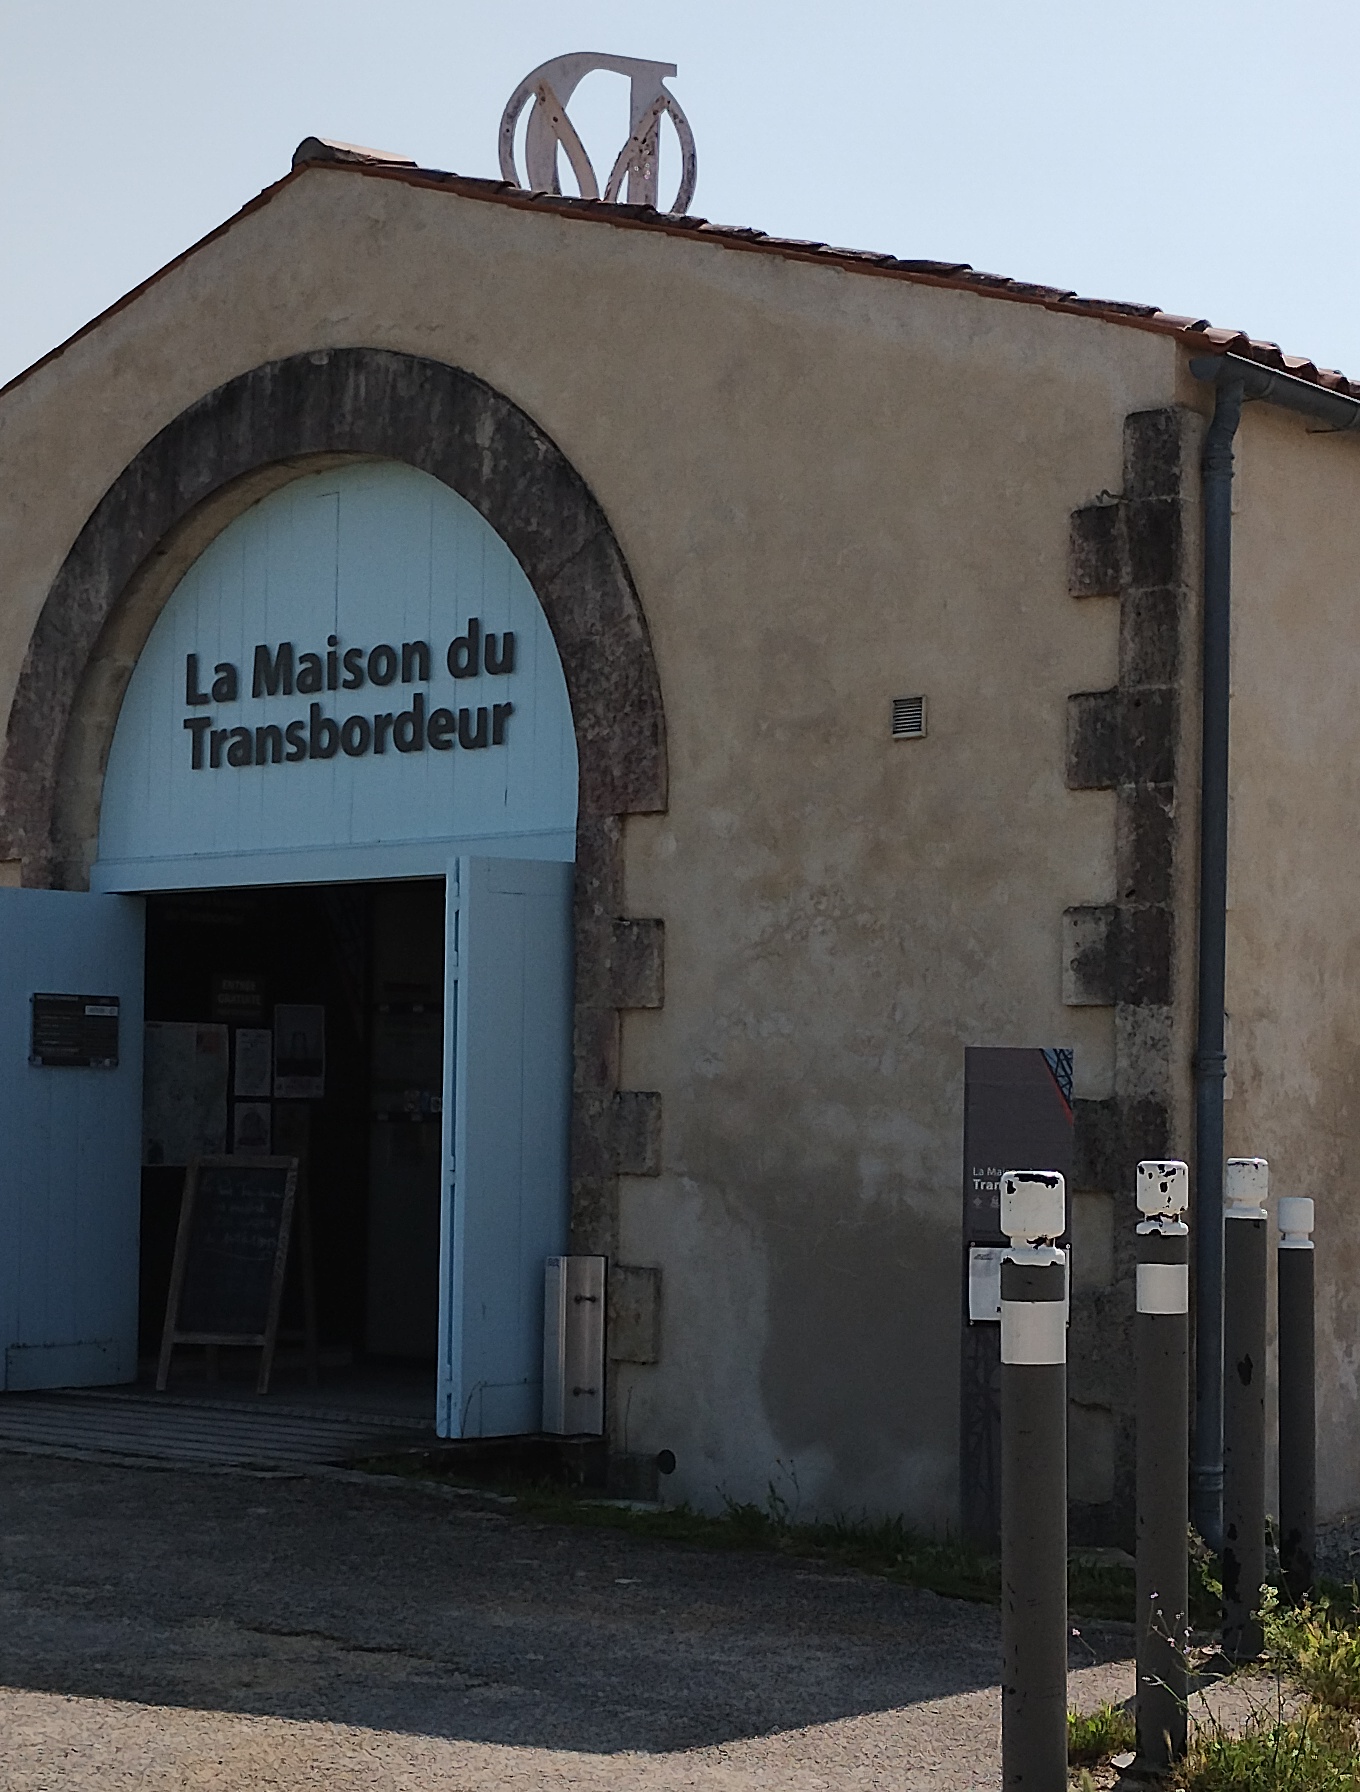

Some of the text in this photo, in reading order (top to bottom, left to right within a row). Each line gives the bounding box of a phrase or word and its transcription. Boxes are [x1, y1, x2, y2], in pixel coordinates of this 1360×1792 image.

[185, 617, 515, 706] La Maison du
[183, 692, 514, 770] Transbordeur
[973, 1167, 985, 1176] La
